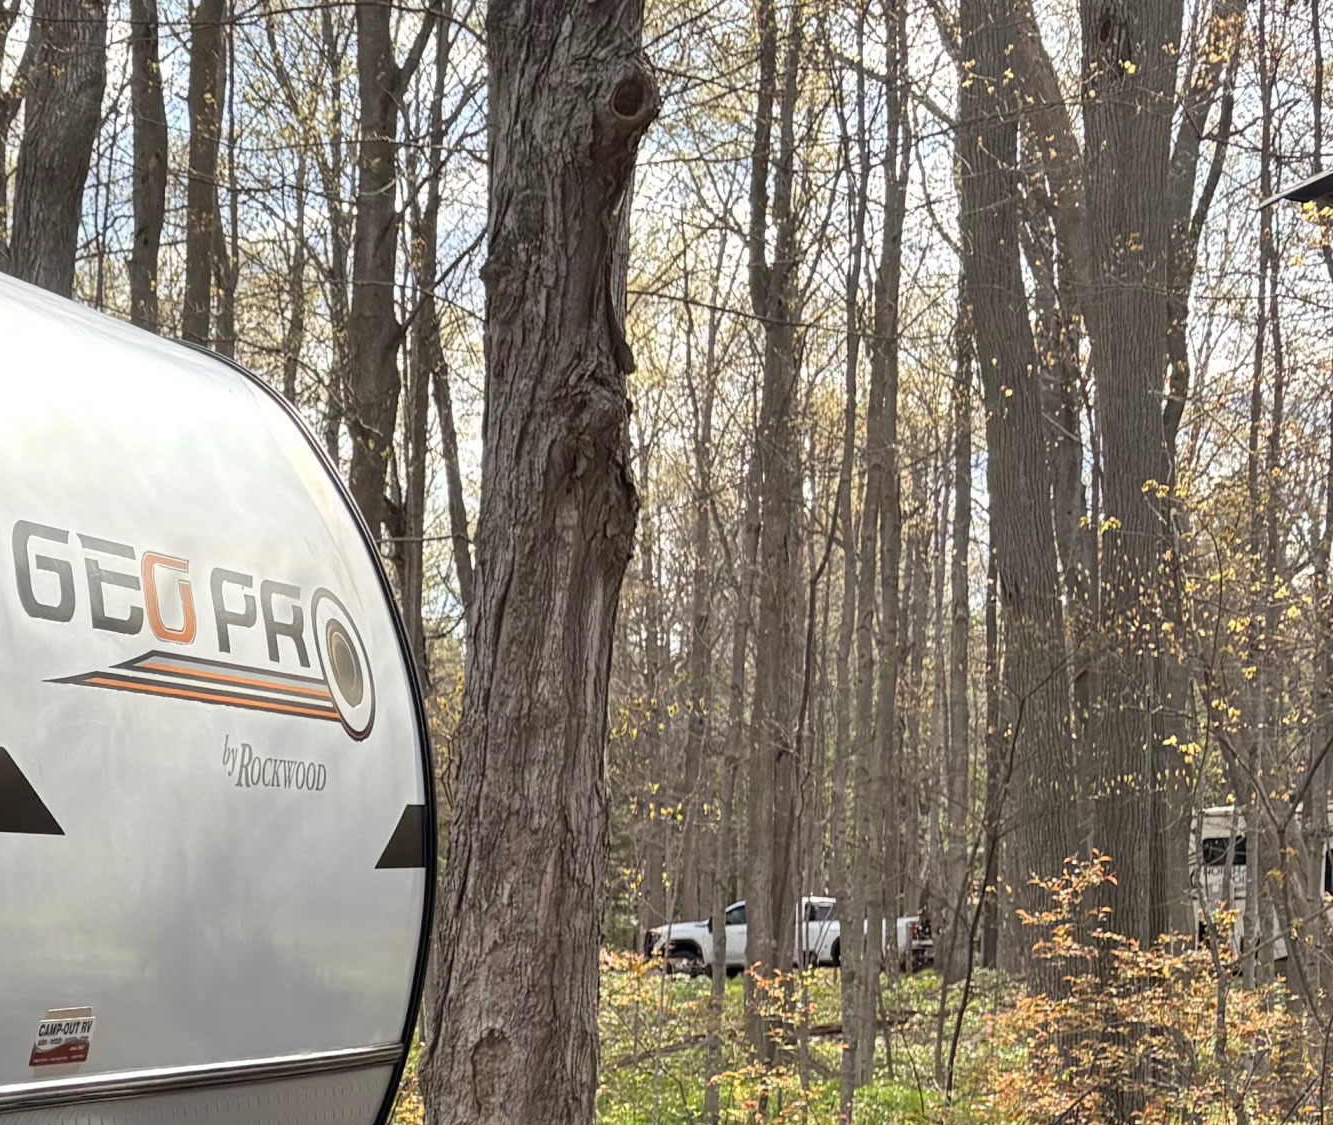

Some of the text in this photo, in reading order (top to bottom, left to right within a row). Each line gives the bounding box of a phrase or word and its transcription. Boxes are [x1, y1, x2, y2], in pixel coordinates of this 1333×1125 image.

[11, 519, 376, 742] GEO PRO
[221, 734, 239, 777] by
[38, 1020, 93, 1037] CAMP-OUT RV
